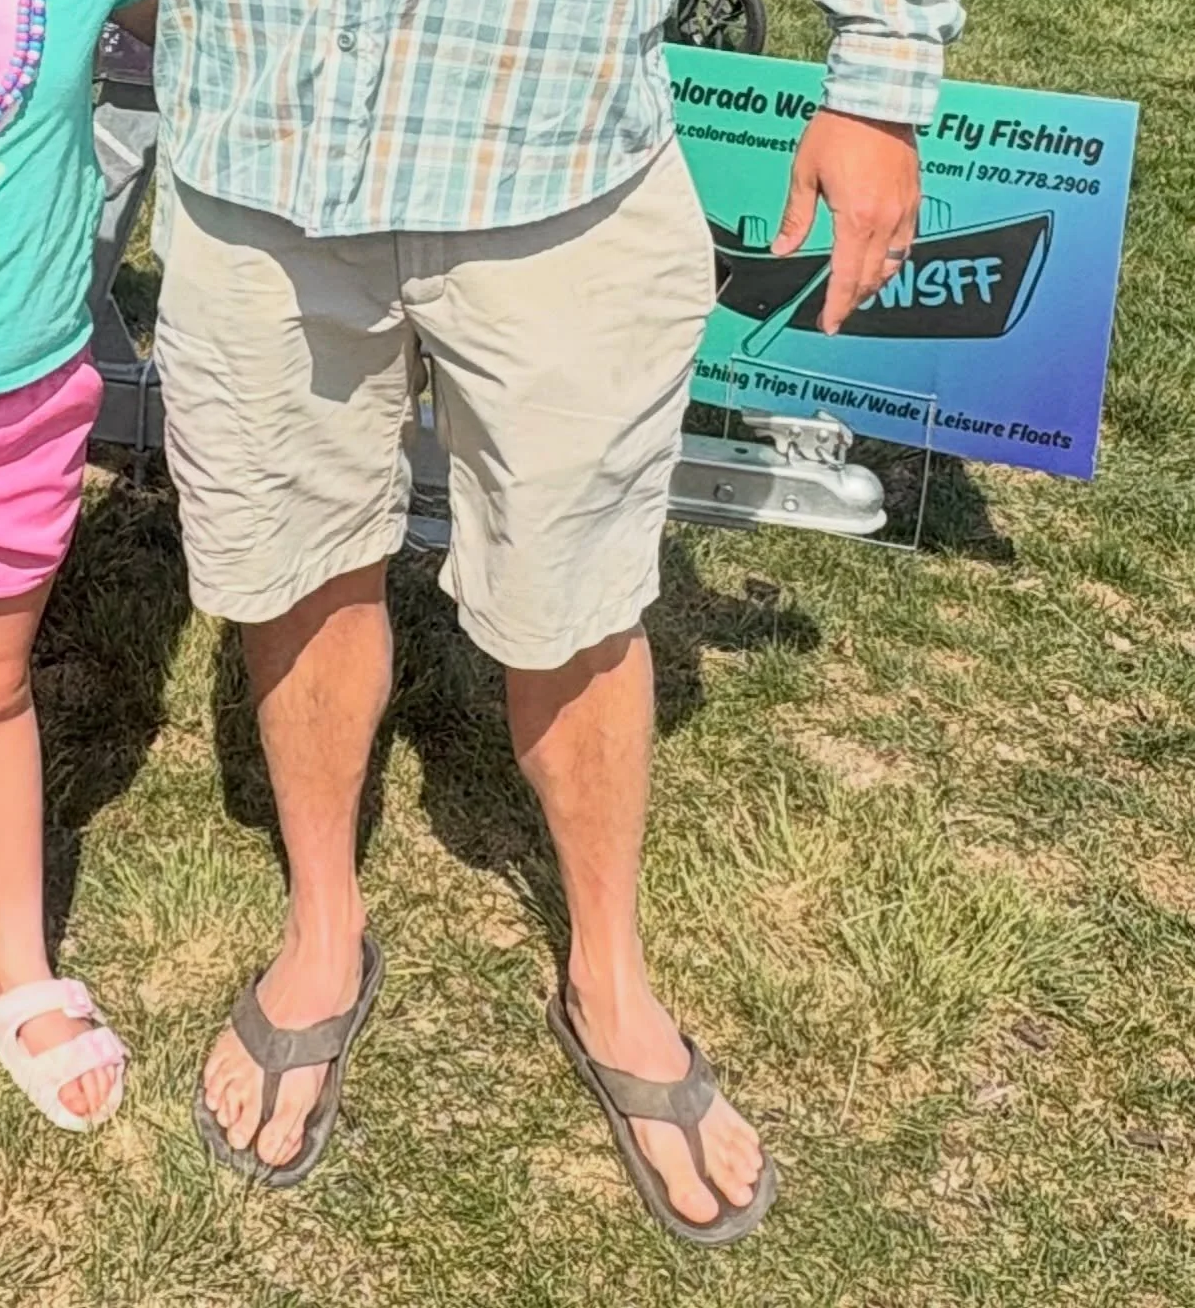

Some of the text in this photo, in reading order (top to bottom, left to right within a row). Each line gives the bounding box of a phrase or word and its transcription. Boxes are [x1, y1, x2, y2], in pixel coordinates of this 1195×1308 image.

[670, 77, 1104, 166] olorado We Fly Fishing
[976, 165, 1101, 195] 970.778.2906
[857, 257, 1003, 310] WSFF
[755, 372, 798, 397] Trips
[812, 383, 920, 422] Walk/Wade
[934, 409, 1005, 438] Leisure
[1008, 423, 1073, 450] Floats
